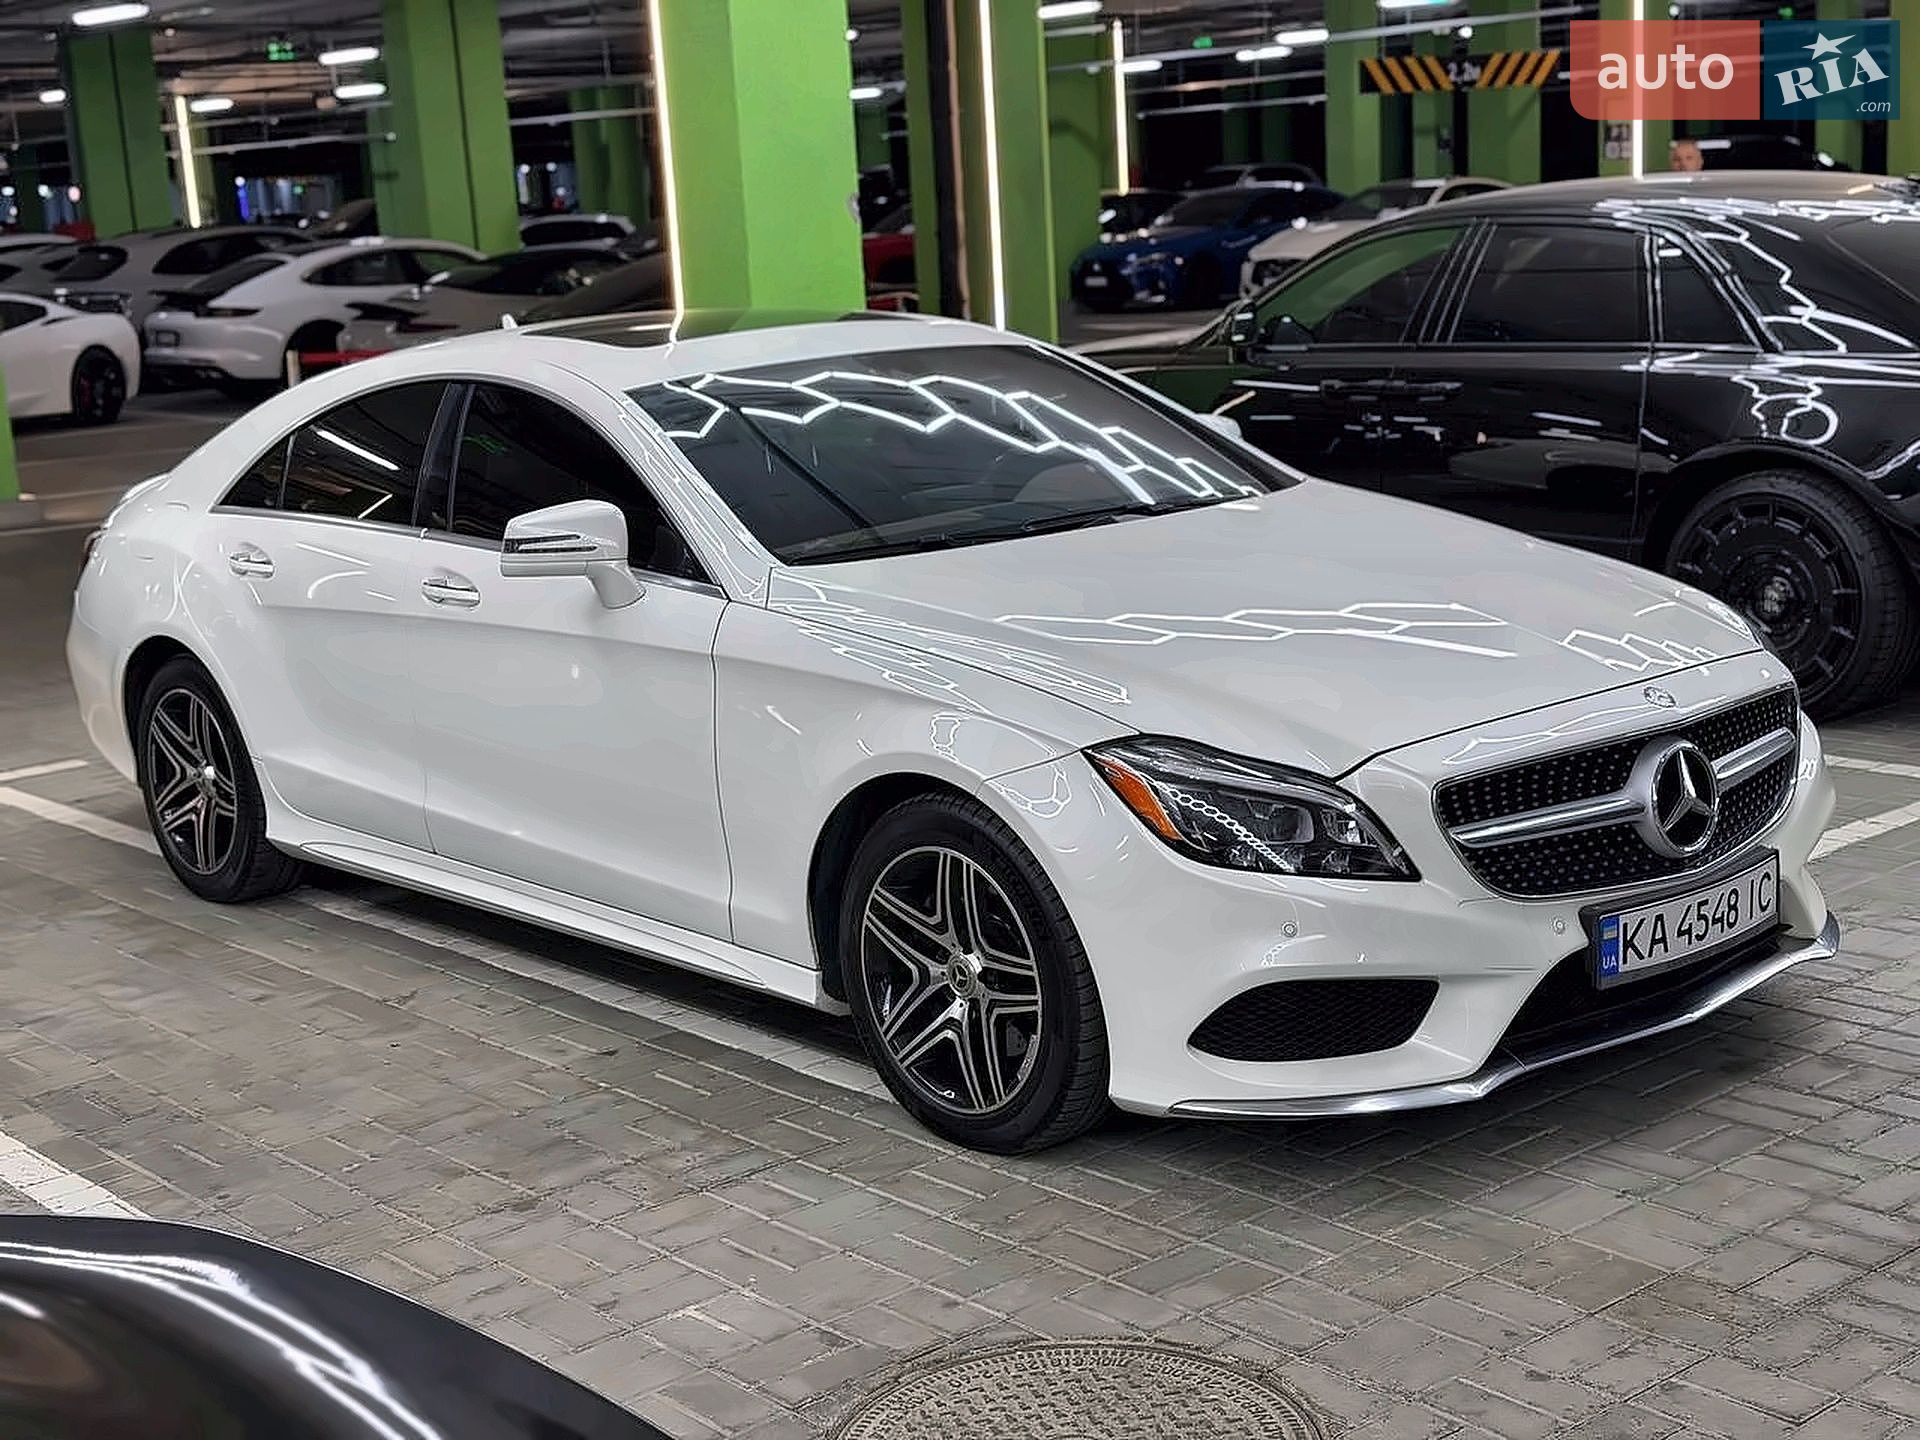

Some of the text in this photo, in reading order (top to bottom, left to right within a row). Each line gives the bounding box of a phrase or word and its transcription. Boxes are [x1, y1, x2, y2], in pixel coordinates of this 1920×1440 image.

[1622, 871, 1772, 965] KA 4548 IC
[1602, 958, 1617, 970] UA
